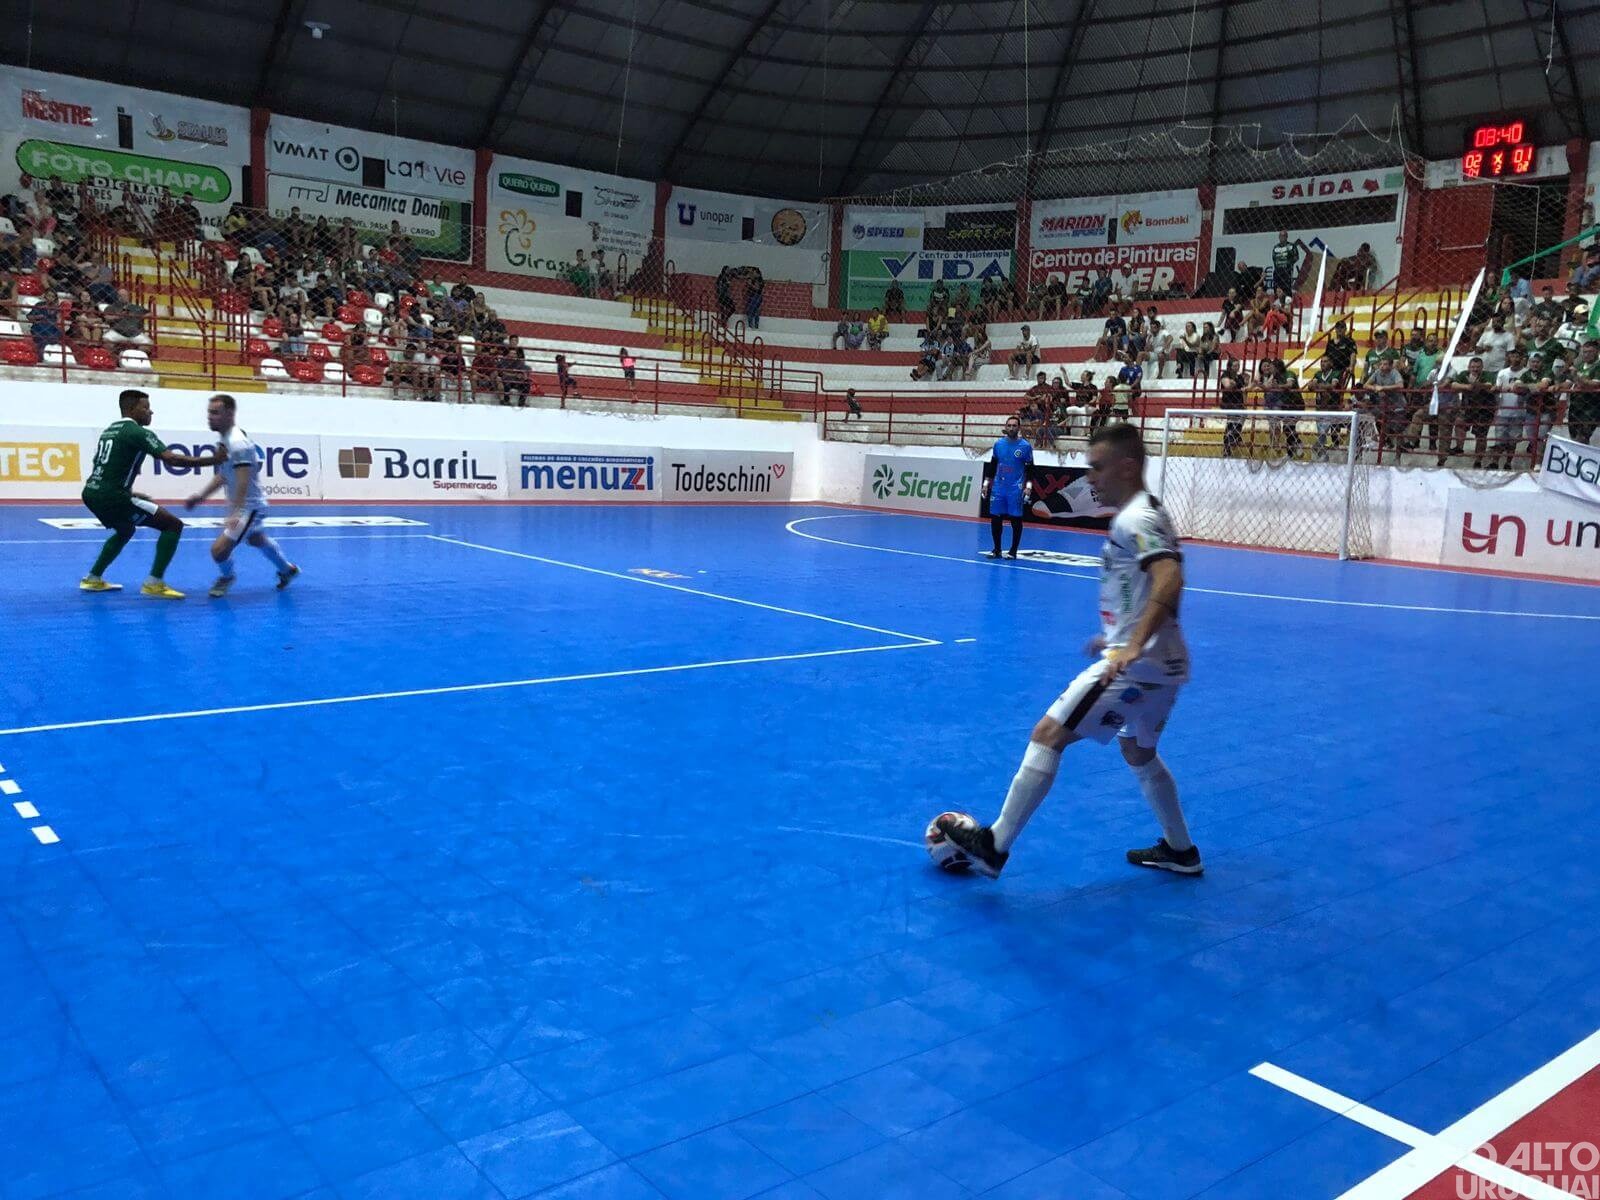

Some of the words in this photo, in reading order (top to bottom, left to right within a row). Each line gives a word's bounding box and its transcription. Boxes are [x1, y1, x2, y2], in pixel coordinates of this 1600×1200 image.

[22, 97, 93, 127] MESTRE
[1475, 124, 1523, 147] 08:40
[273, 140, 329, 161] VMAT
[1466, 154, 1482, 169] 02
[1514, 147, 1533, 163] 01
[29, 150, 112, 177] FOTO
[124, 165, 220, 193] CHAPA
[502, 176, 529, 189] QUERO
[529, 180, 557, 193] QUERO
[1271, 174, 1355, 199] SAÍDA
[700, 209, 735, 225] unopar
[1040, 213, 1107, 231] MARION
[1145, 214, 1189, 227] Bomdaki
[881, 251, 1007, 280] VIDA
[1031, 250, 1093, 269] Centro
[1094, 248, 1116, 265] de
[1117, 246, 1196, 265] Pinturas
[0, 447, 65, 477] TEC
[433, 480, 497, 491] Supermercado
[672, 463, 772, 493] Todeschini
[897, 471, 973, 503] Sicredi
